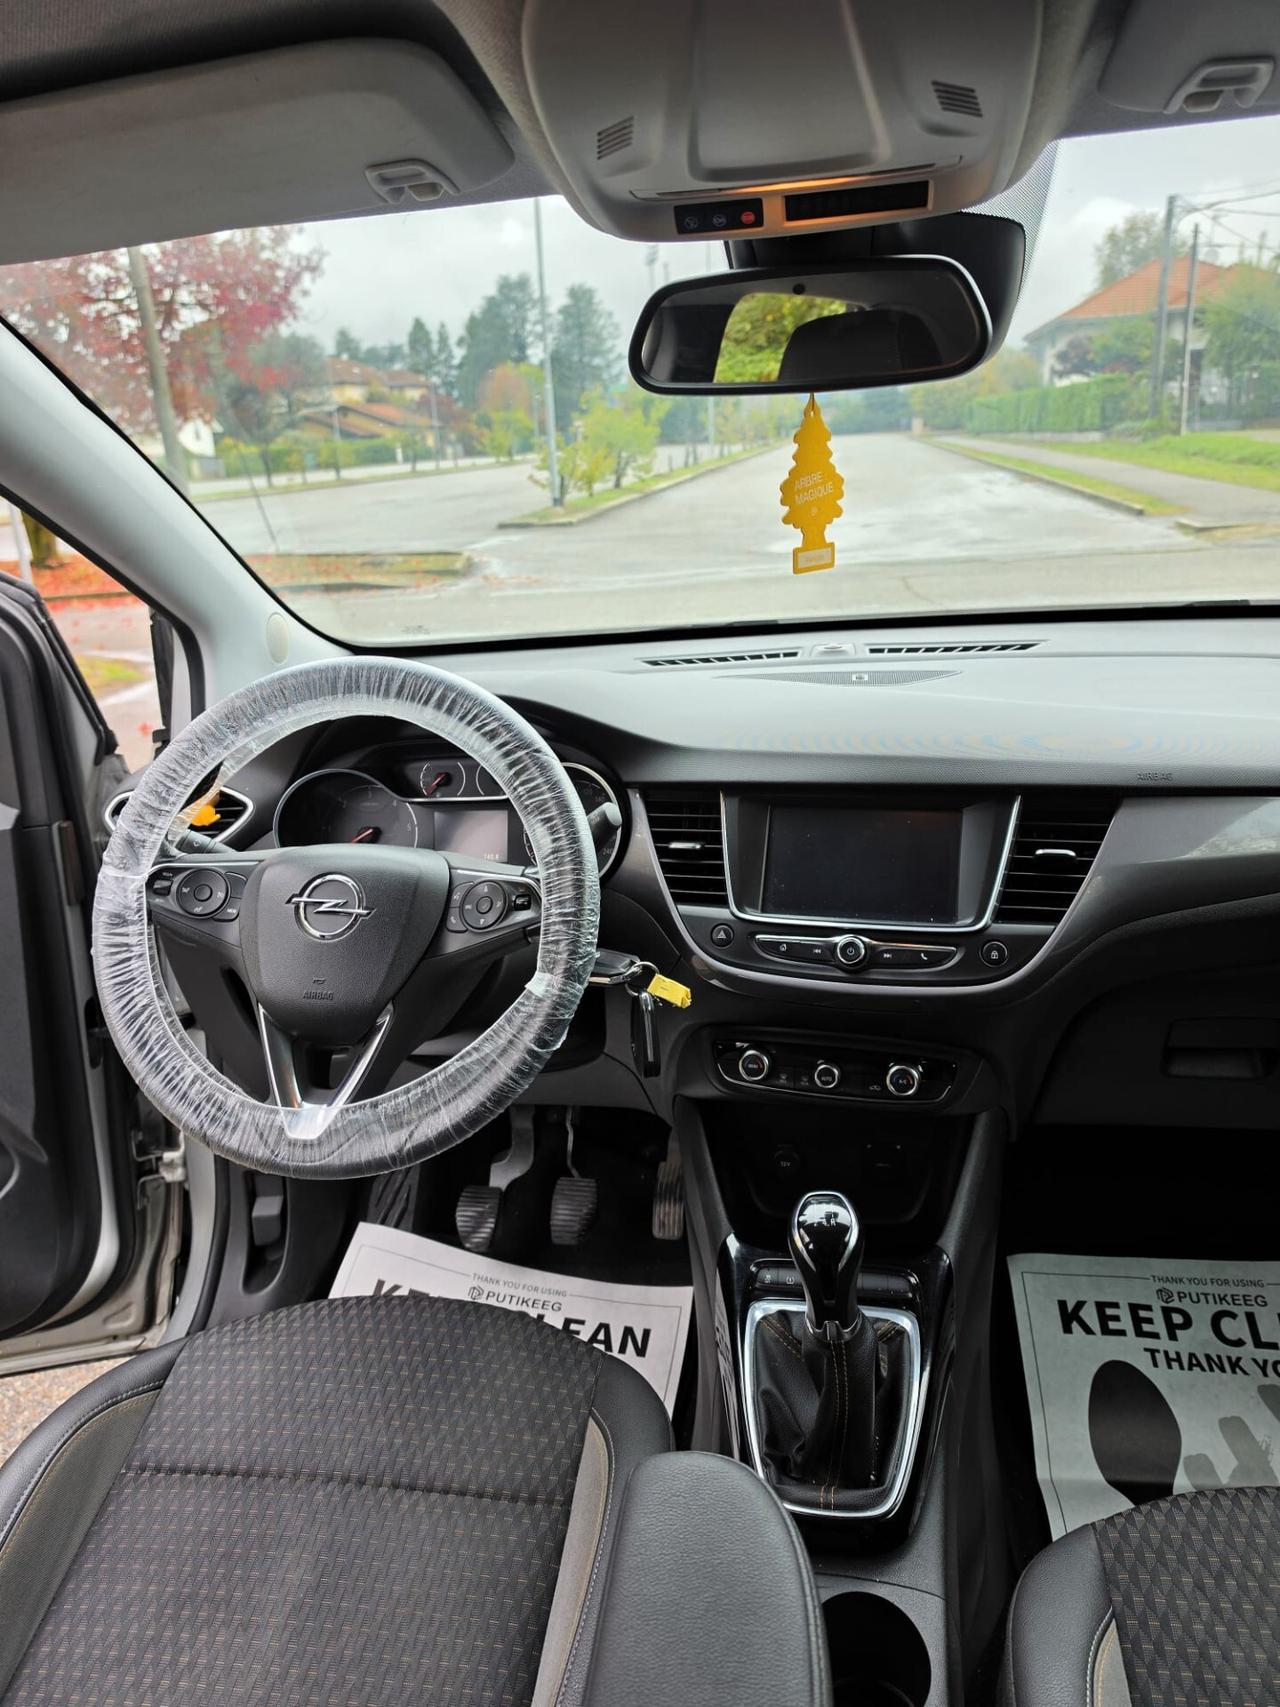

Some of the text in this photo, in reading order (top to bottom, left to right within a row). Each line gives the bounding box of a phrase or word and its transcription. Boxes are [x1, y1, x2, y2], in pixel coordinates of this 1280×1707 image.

[794, 472, 823, 490] ARBRE
[794, 482, 833, 505] MAGIQUE
[1136, 772, 1174, 782] AIRBAG
[303, 991, 334, 1001] AIRBAG
[473, 1273, 567, 1297] THANK YOU FOR USING
[1151, 1275, 1265, 1288] THANK YOU FOR USING
[485, 1291, 562, 1312] PUTIKEEG
[1177, 1291, 1268, 1307] PUTIKEEG
[1057, 1299, 1280, 1350] KEEP CL
[1144, 1347, 1250, 1376] THANK
